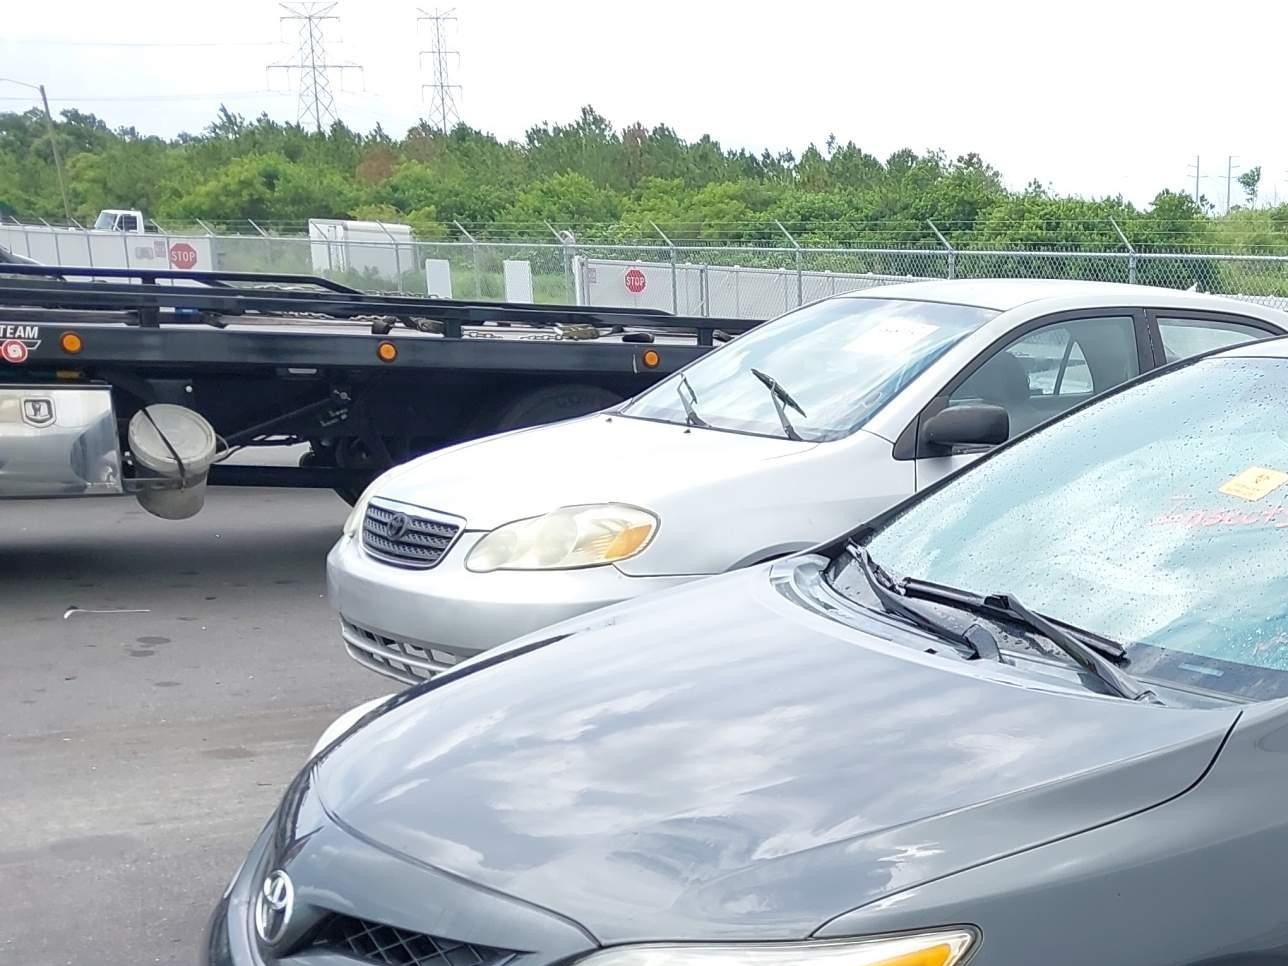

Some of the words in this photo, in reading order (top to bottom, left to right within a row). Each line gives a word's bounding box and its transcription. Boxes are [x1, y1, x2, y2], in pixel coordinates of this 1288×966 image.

[171, 250, 196, 262] STOP
[626, 276, 645, 286] STOP
[0, 325, 39, 339] TEAM
